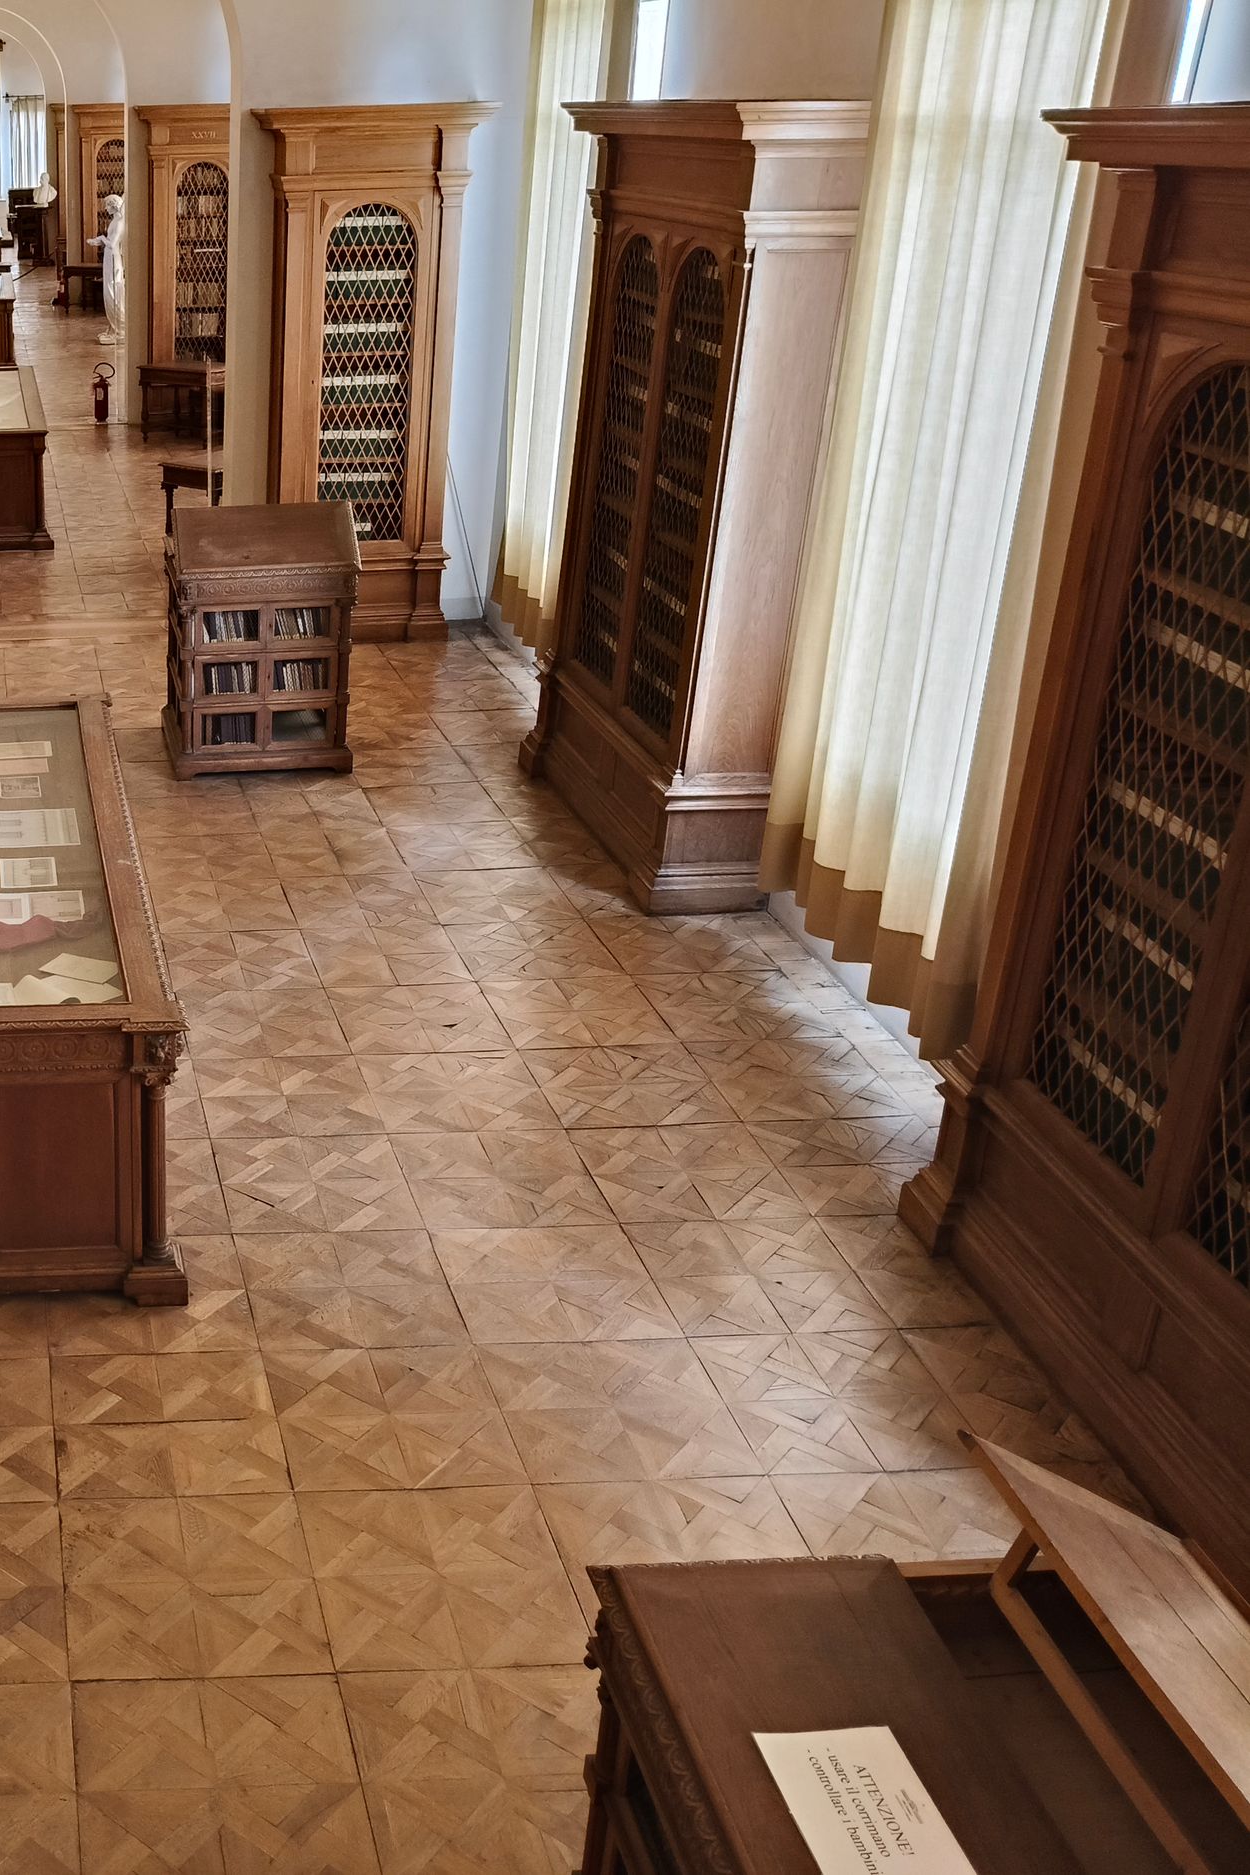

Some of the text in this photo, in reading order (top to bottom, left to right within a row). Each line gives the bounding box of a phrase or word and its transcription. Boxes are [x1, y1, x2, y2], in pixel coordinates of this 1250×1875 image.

[828, 1755, 850, 1783] usare
[846, 1787, 860, 1795] il
[809, 1756, 848, 1817] controllare
[846, 1827, 884, 1875] bambini
[852, 1791, 891, 1858] corrimano
[853, 1765, 915, 1856] ATTENZIONE!
